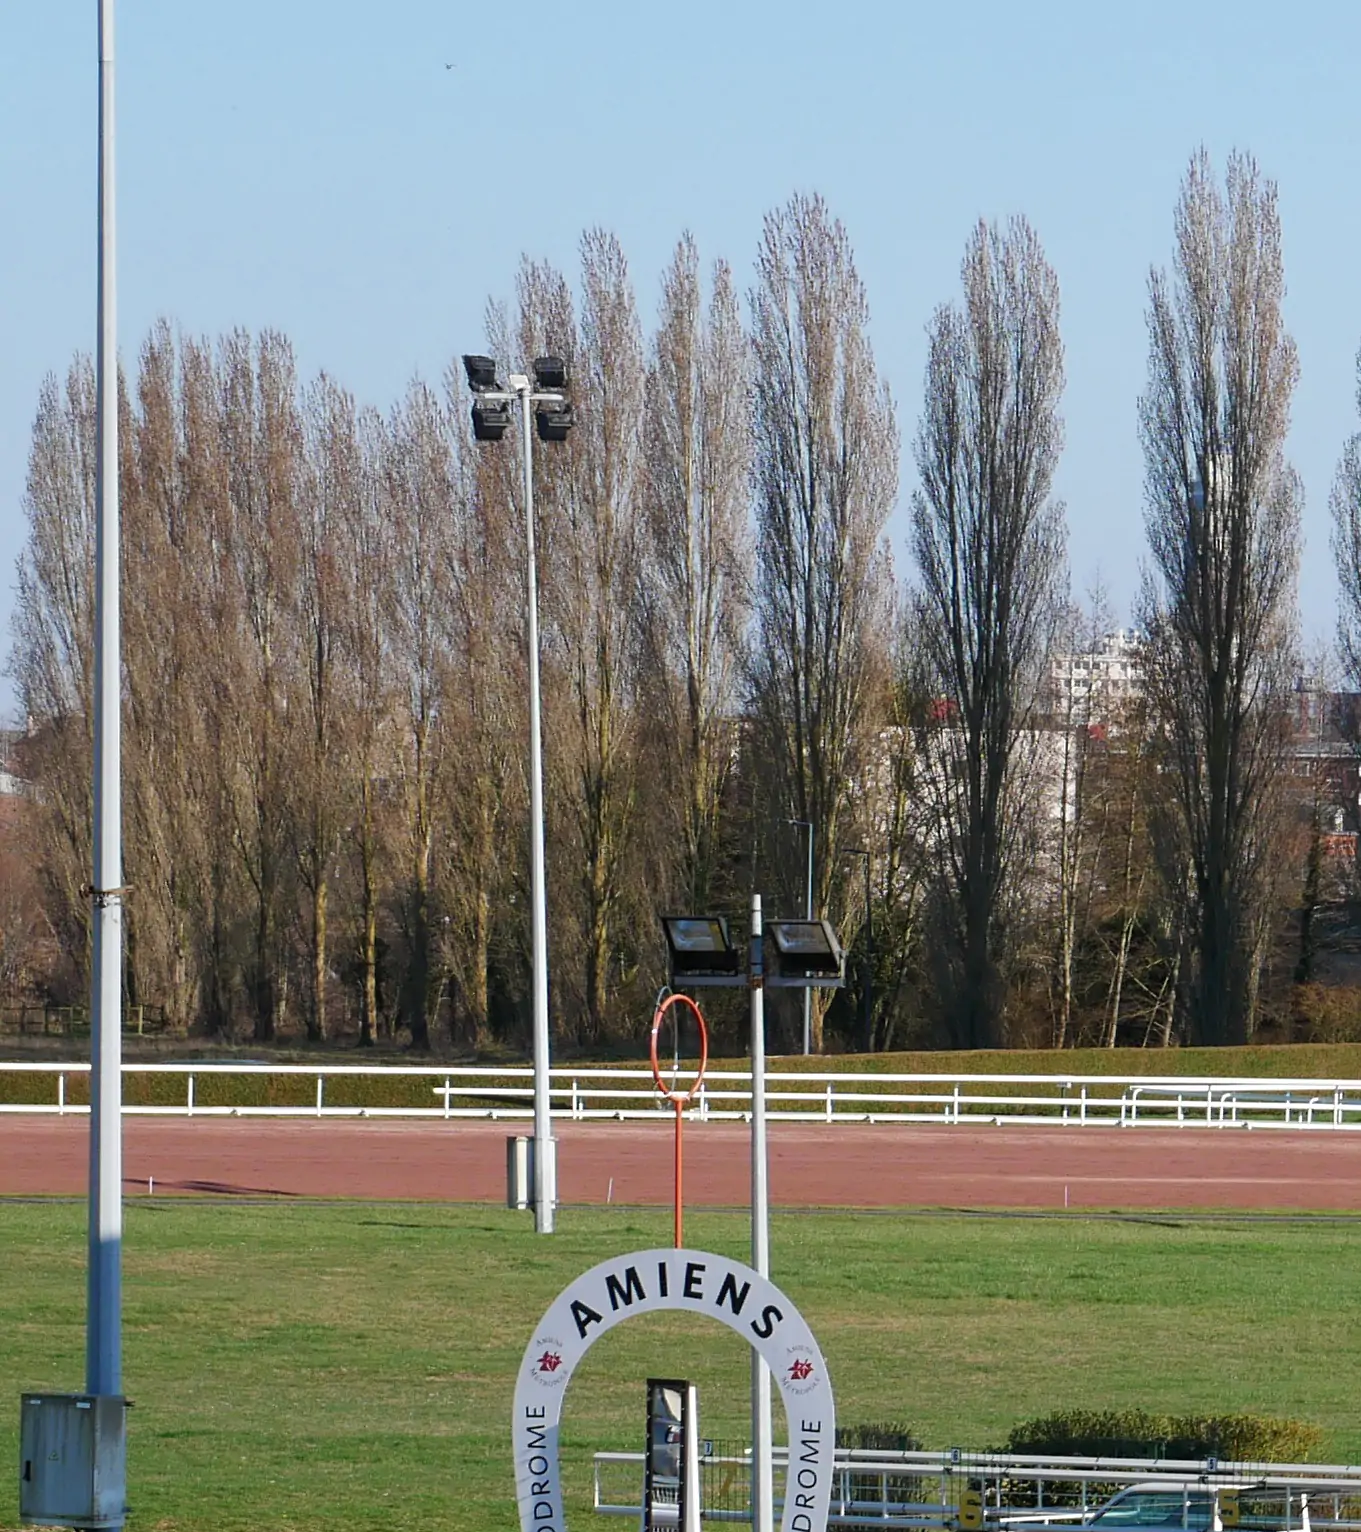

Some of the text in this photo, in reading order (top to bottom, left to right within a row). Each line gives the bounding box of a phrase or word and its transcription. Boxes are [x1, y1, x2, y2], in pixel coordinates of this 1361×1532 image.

[569, 1261, 784, 1339] AMIENS
[960, 1491, 981, 1528] 6
[1218, 1488, 1239, 1526] 5
